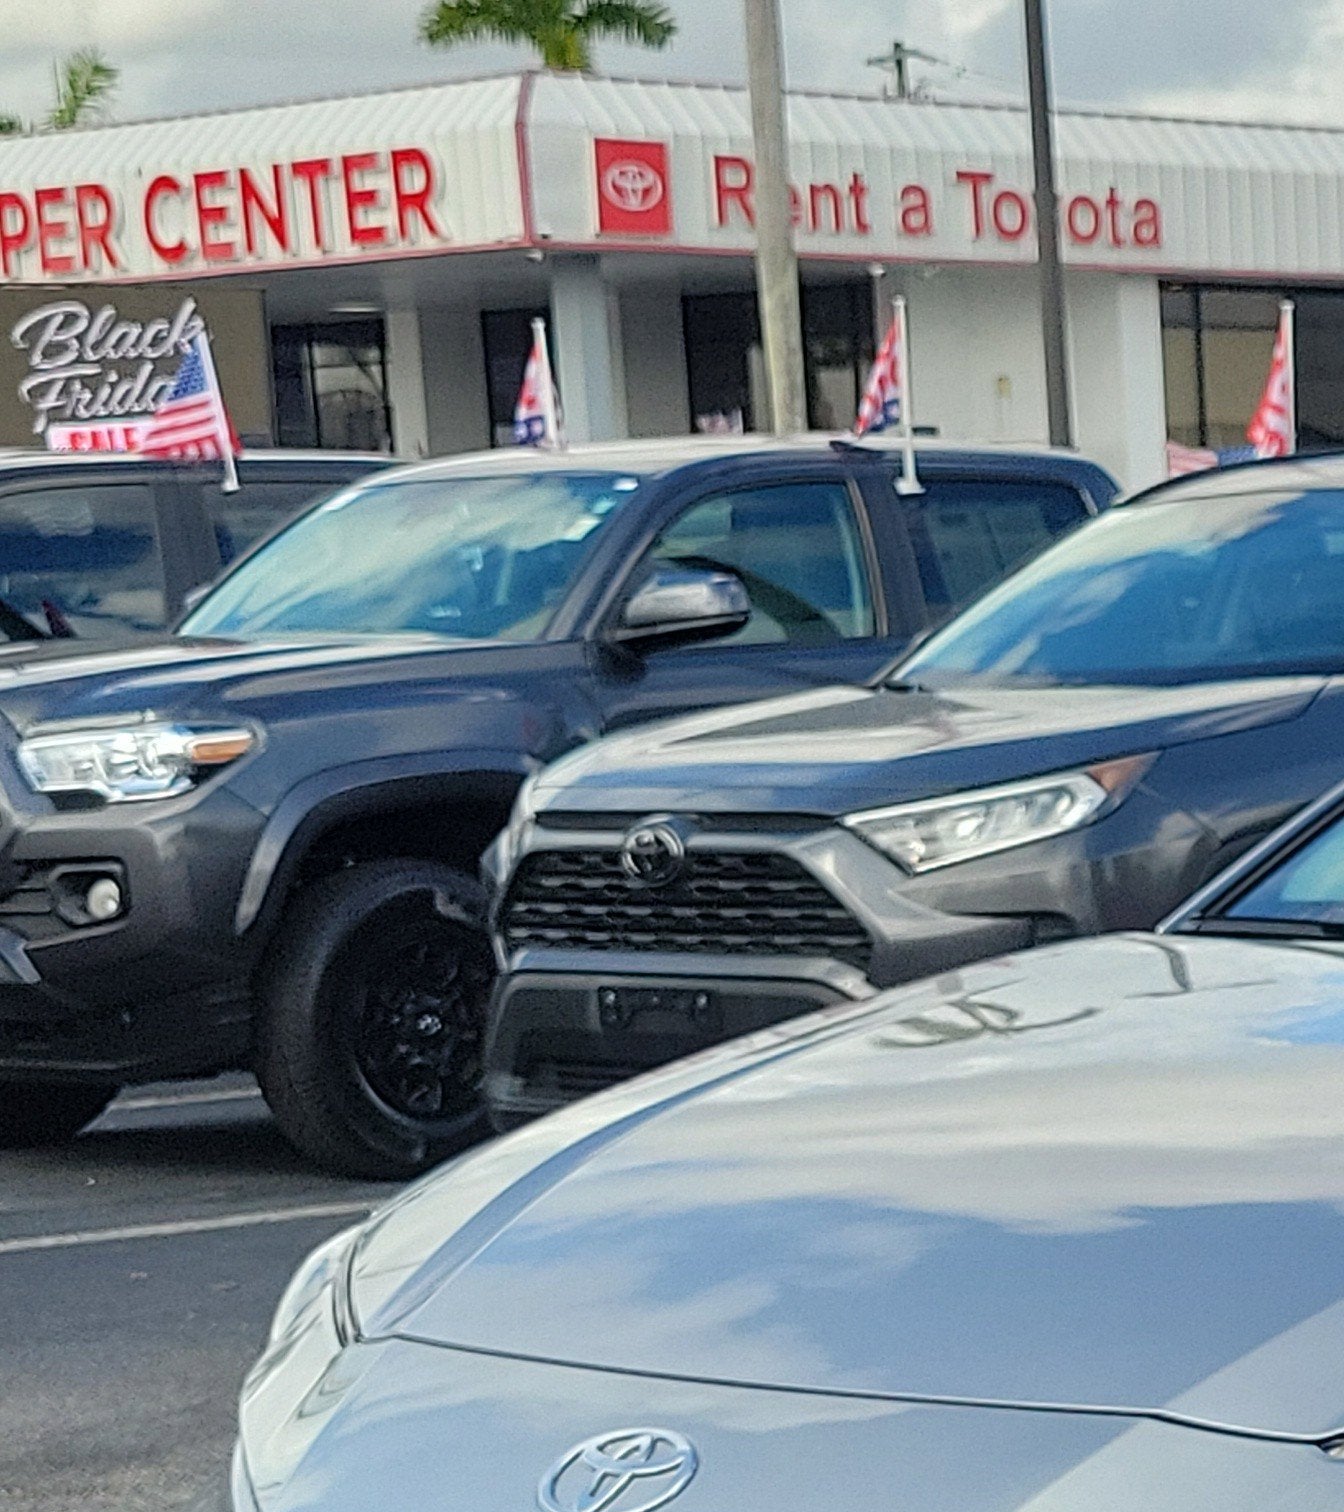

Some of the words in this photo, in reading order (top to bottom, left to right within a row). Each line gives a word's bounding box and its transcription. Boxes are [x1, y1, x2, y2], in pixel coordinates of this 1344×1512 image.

[0, 183, 117, 278] PER
[144, 148, 440, 264] CENTER
[714, 155, 870, 234] Rnt
[900, 184, 932, 235] a
[956, 171, 1161, 248] Toota
